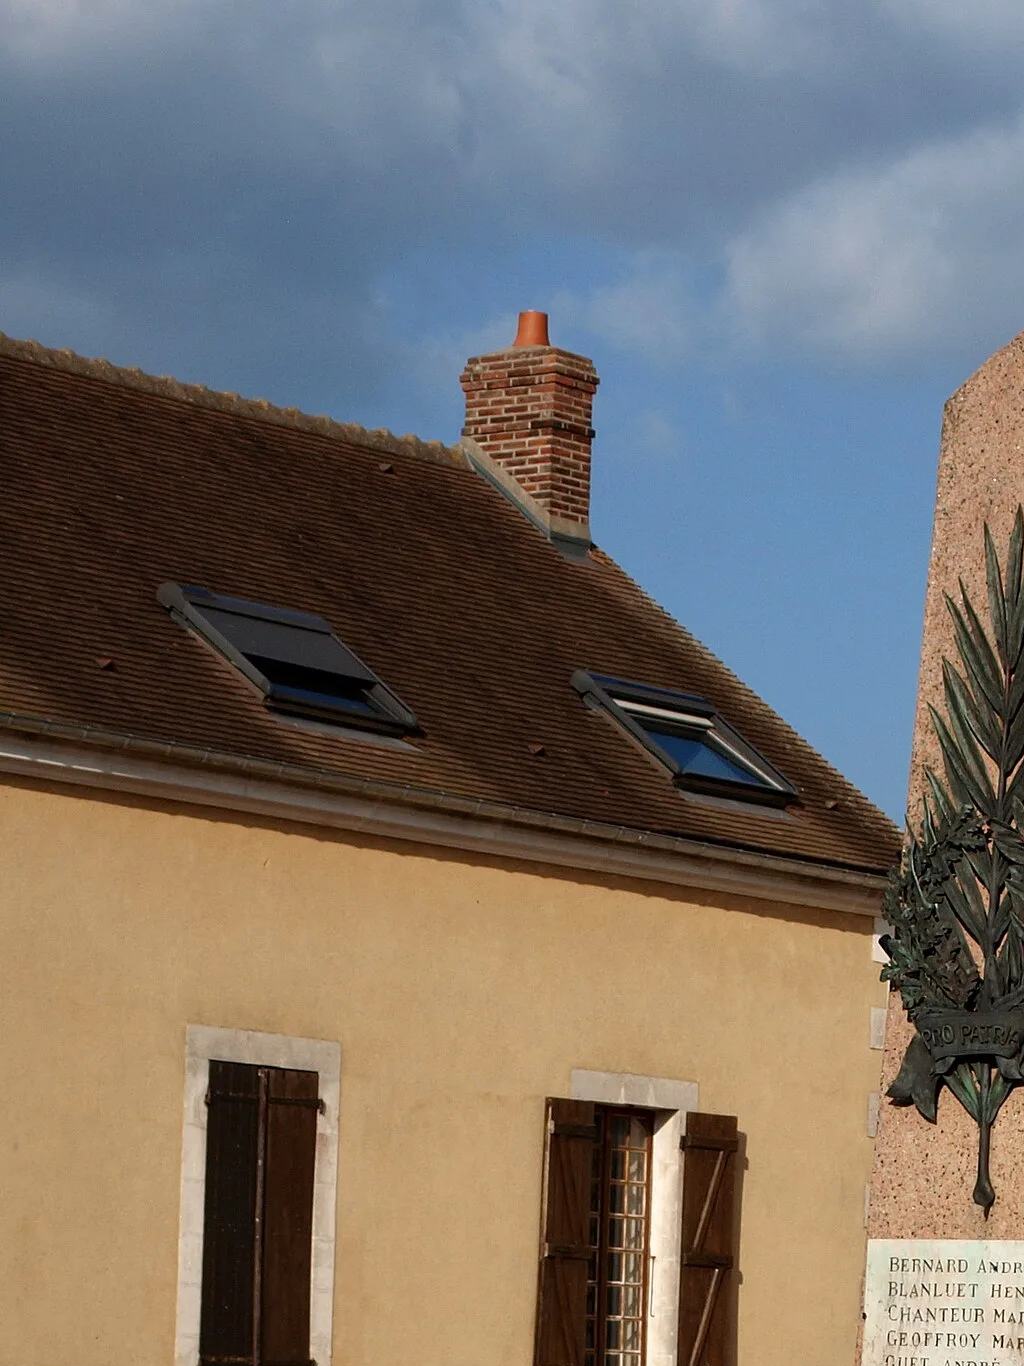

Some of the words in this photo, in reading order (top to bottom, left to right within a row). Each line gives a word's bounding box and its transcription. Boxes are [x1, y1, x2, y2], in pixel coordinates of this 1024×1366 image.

[921, 1025, 955, 1048] PRO
[960, 1025, 1019, 1047] PATRIA
[889, 1257, 968, 1273] BERNARD
[888, 1282, 979, 1298] BLANLUET
[888, 1305, 985, 1323] CHANTEUR
[887, 1331, 980, 1348] GEOFFROY
